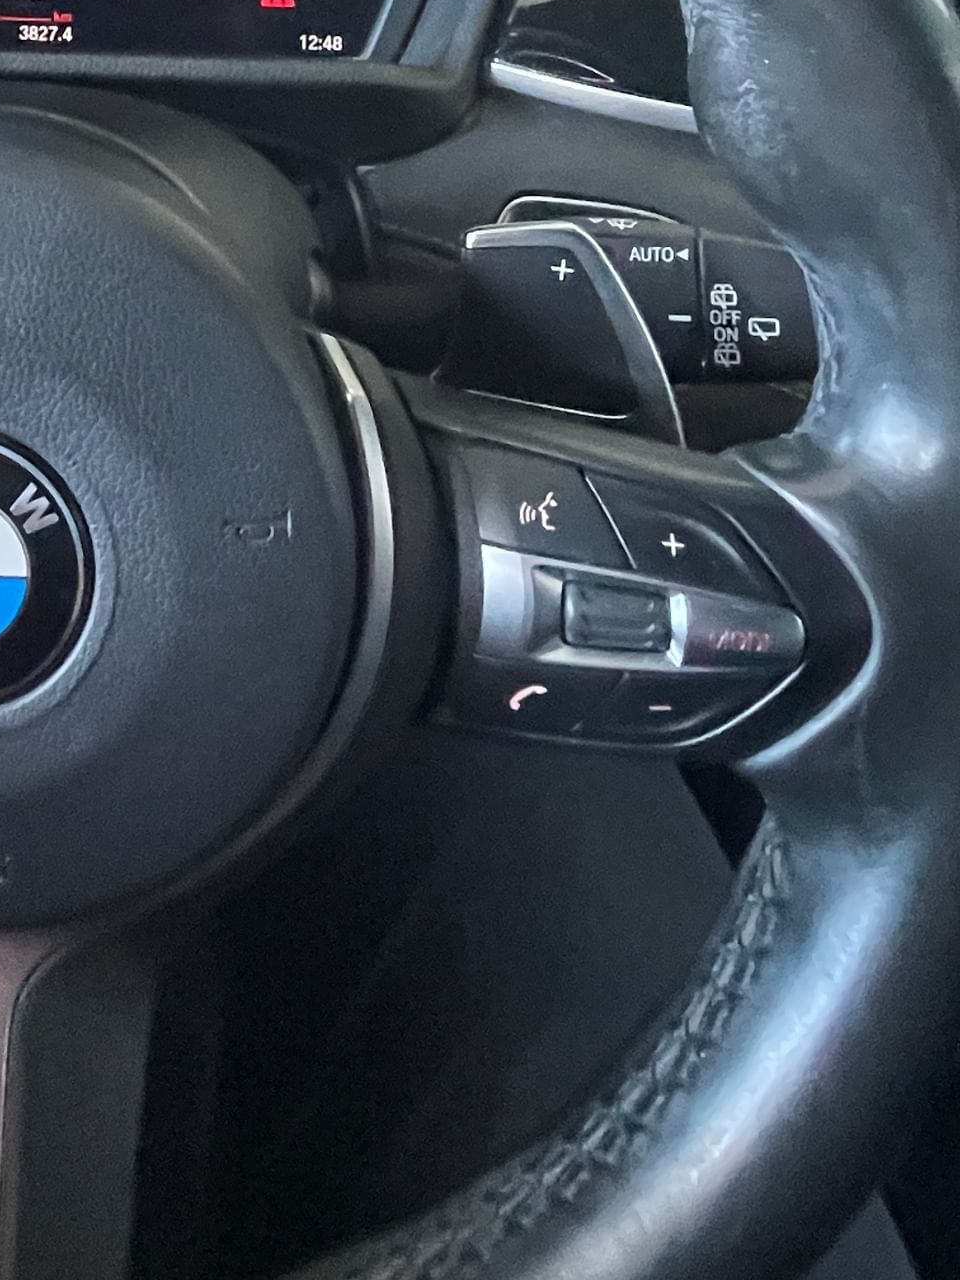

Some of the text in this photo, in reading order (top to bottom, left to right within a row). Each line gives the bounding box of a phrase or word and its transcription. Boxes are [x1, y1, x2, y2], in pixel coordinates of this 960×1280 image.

[18, 24, 74, 43] 3827.4
[299, 34, 343, 51] 12:48
[628, 246, 675, 263] AUTO
[709, 307, 742, 326] OFF
[713, 326, 739, 342] ON
